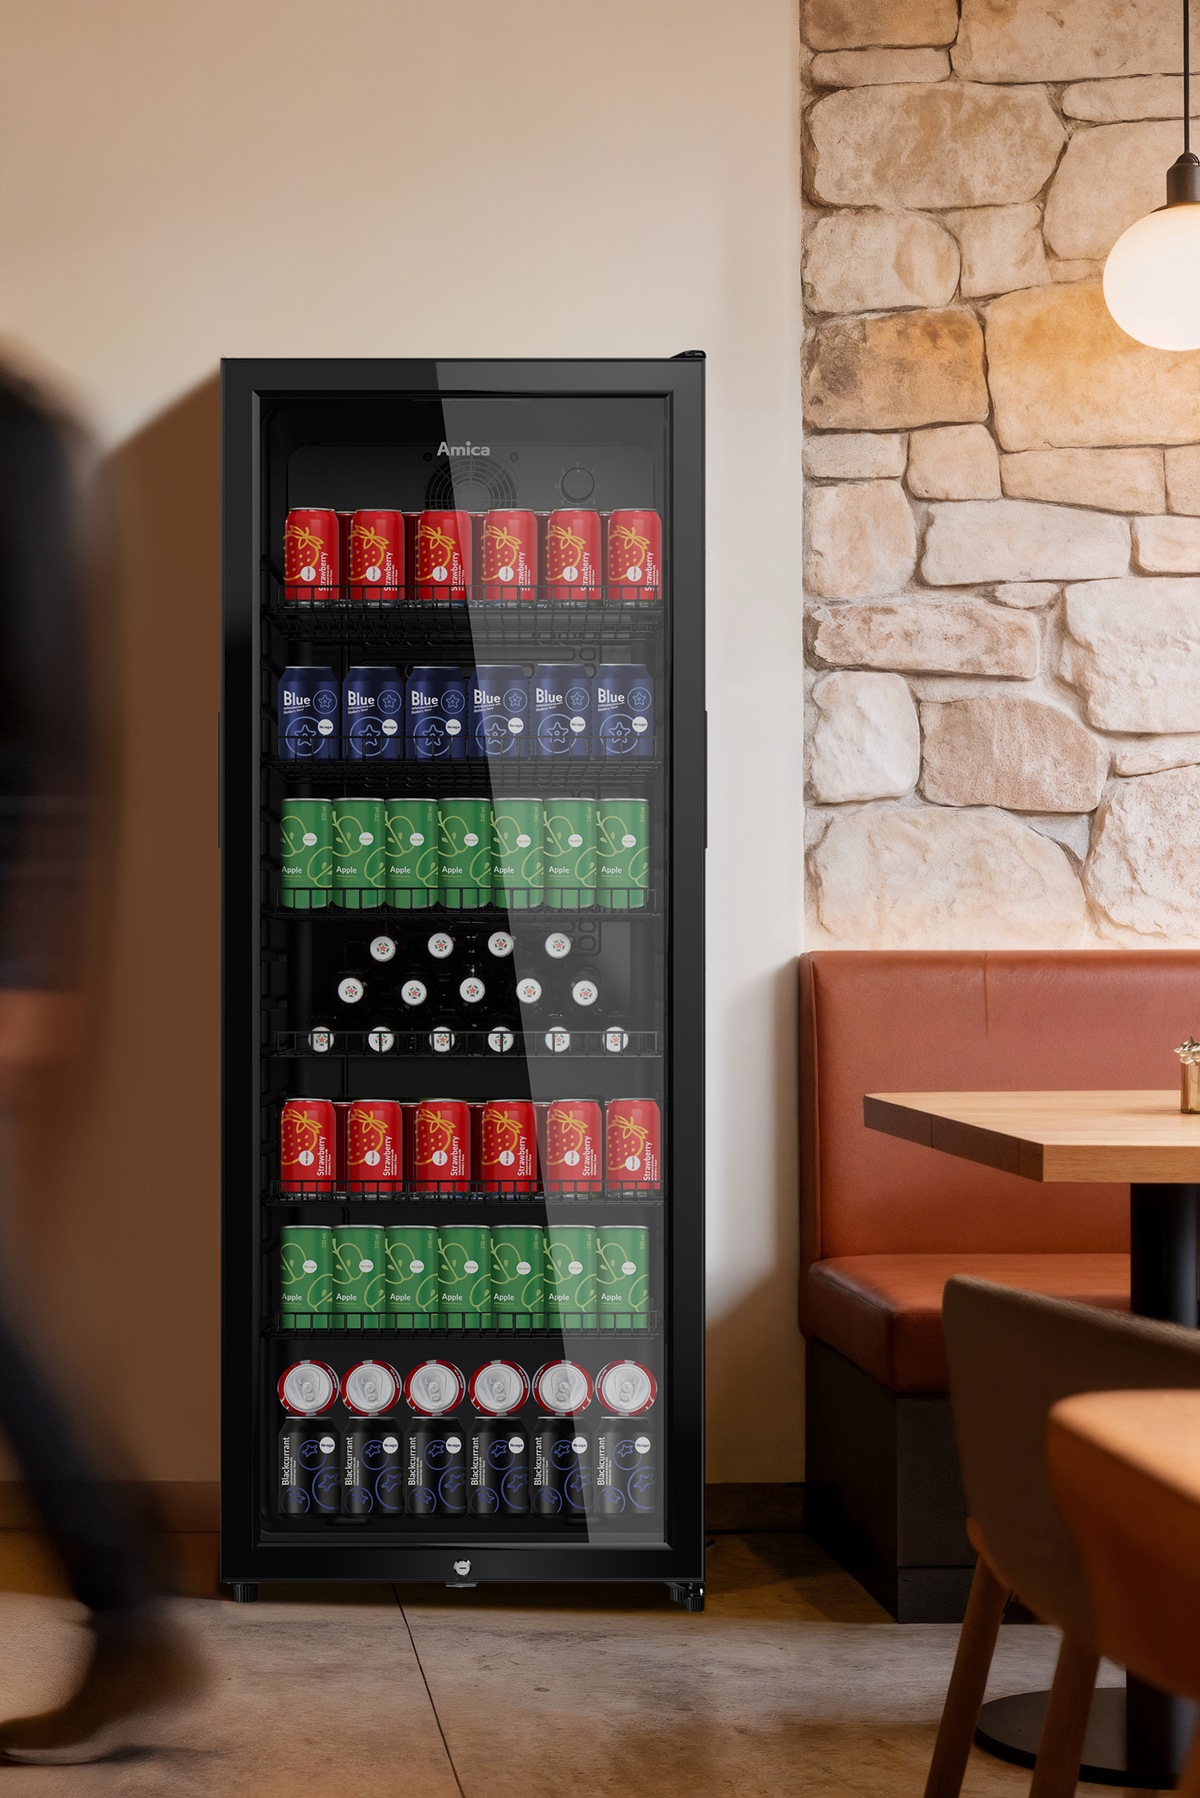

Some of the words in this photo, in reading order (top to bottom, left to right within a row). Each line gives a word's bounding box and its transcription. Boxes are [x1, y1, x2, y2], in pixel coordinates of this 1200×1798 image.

[437, 441, 490, 456] Amica
[283, 690, 310, 706] Blue
[348, 690, 375, 706] Blue
[411, 690, 438, 706] Blue
[474, 688, 501, 704] Blue
[536, 687, 563, 703] Blue
[598, 687, 625, 703] Blue
[282, 866, 302, 874] Apple
[336, 866, 357, 874] Apple
[390, 866, 411, 874] Apple
[442, 866, 463, 874] Apple
[494, 866, 515, 874] Apple
[549, 866, 570, 874] Apple
[601, 866, 622, 874] Apple
[316, 1136, 326, 1176] Strawberry
[382, 1136, 392, 1176] Strawberry
[450, 1136, 460, 1176] Strawberry
[517, 1136, 527, 1176] Strawberry
[582, 1136, 592, 1176] Strawberry
[643, 1141, 653, 1181] Strawberry
[282, 1293, 302, 1301] Apple
[336, 1293, 357, 1301] Apple
[390, 1293, 411, 1301] Apple
[442, 1293, 463, 1301] Apple
[494, 1293, 515, 1301] Apple
[549, 1293, 570, 1301] Apple
[601, 1293, 622, 1301] Apple
[282, 1437, 290, 1486] Blackcurrant
[345, 1437, 353, 1486] Blackcurrant
[408, 1437, 416, 1486] Blackcurrant
[470, 1437, 479, 1486] Blackcurrant
[534, 1437, 542, 1486] Blackcurrant
[597, 1437, 605, 1486] Blackcurrant
